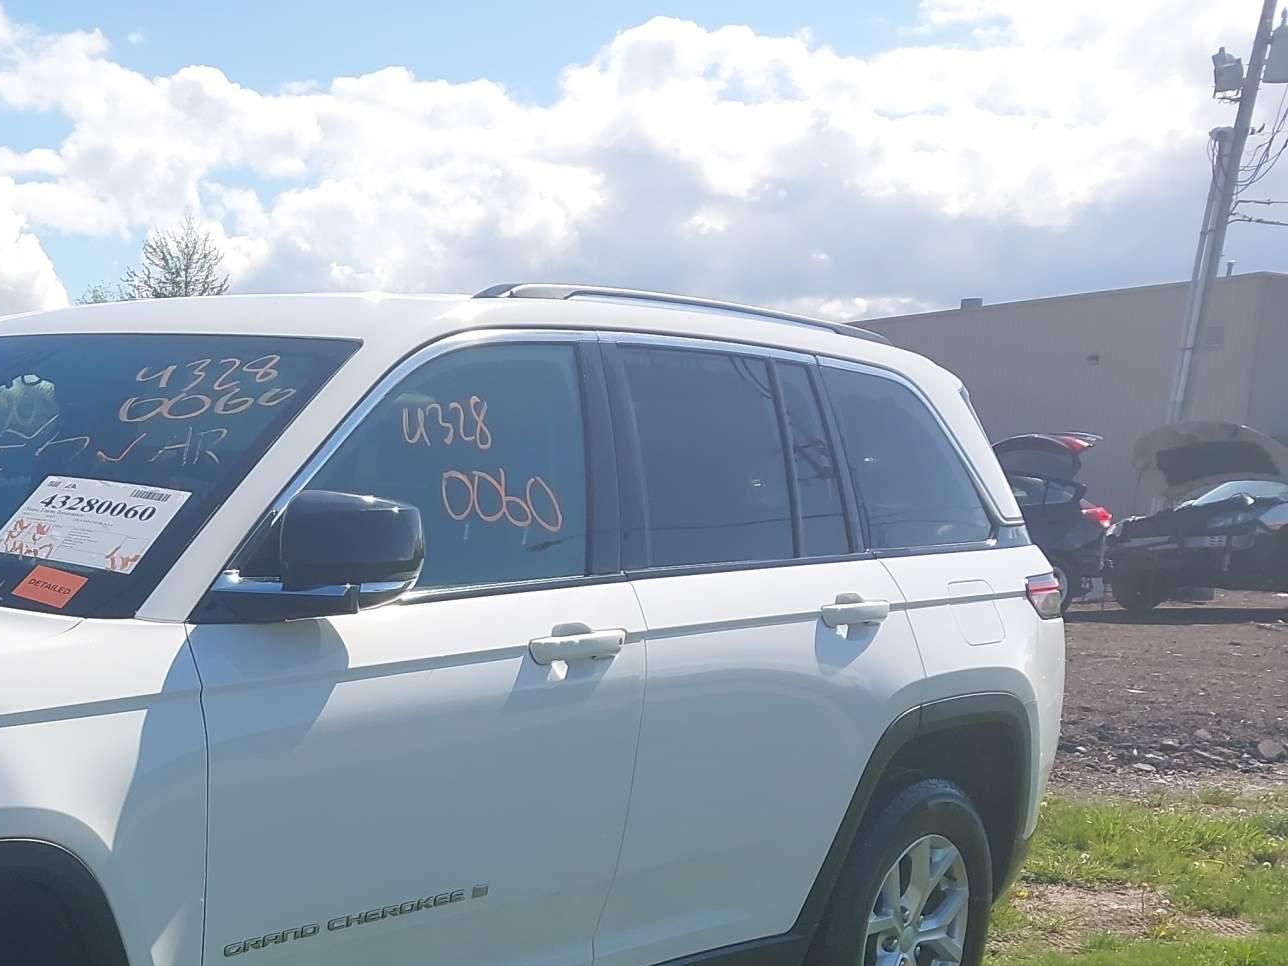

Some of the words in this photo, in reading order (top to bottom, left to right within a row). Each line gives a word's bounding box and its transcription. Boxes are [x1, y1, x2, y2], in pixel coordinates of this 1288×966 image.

[135, 354, 281, 392] 4328
[118, 388, 297, 423] 0060
[402, 395, 492, 450] 4328
[40, 493, 157, 522] 43280060
[442, 468, 563, 533] 0060
[27, 577, 71, 596] DETAILED
[223, 922, 321, 958] GRAND
[327, 888, 465, 932] CHEROKEE
